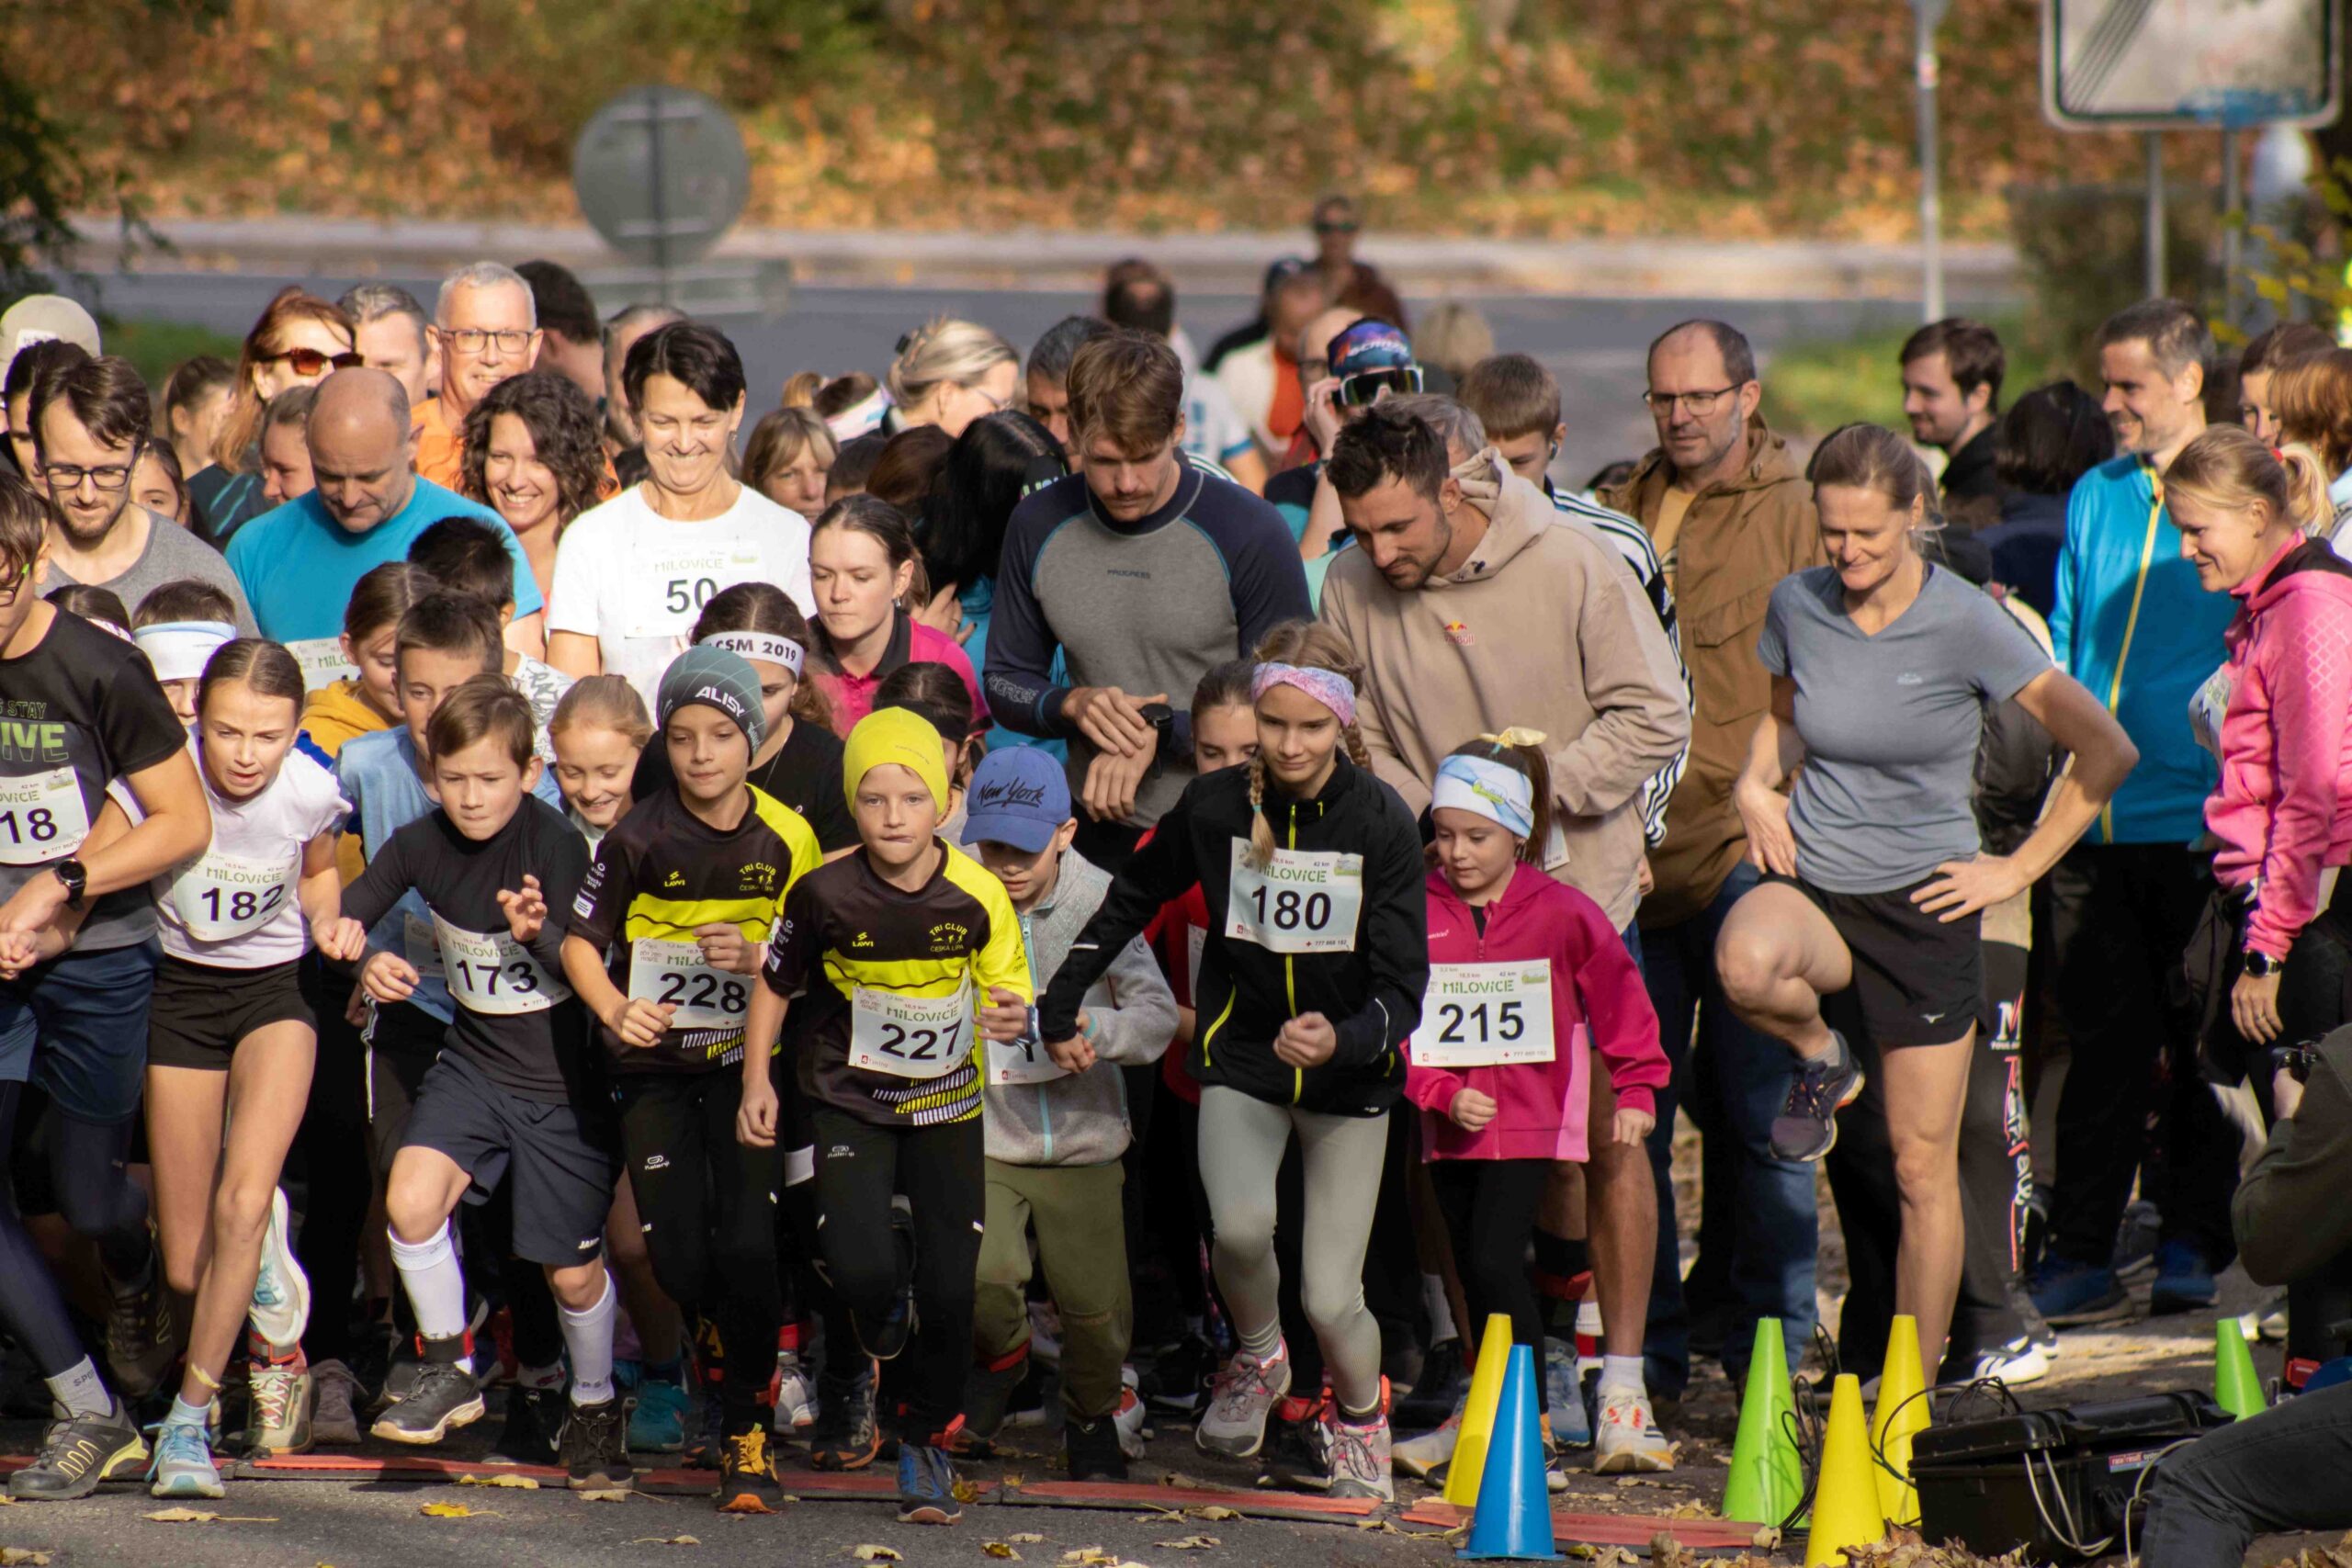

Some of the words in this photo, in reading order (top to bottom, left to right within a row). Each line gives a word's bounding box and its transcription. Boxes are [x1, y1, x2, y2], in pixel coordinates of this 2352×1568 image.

[666, 577, 718, 615] 50
[762, 641, 797, 661] 2019
[7, 701, 47, 719] STAY
[695, 686, 746, 718] ALISY
[978, 780, 1010, 806] New
[1001, 776, 1046, 807] York
[739, 863, 754, 875] TRI
[755, 862, 776, 876] CLUB
[201, 884, 286, 922] 182
[1251, 885, 1331, 931] 180
[929, 924, 944, 937] TRI
[944, 922, 967, 936] CLUB
[456, 958, 538, 996] 173
[657, 972, 747, 1014] 228
[879, 1017, 963, 1060] 227
[1439, 1001, 1524, 1043] 215
